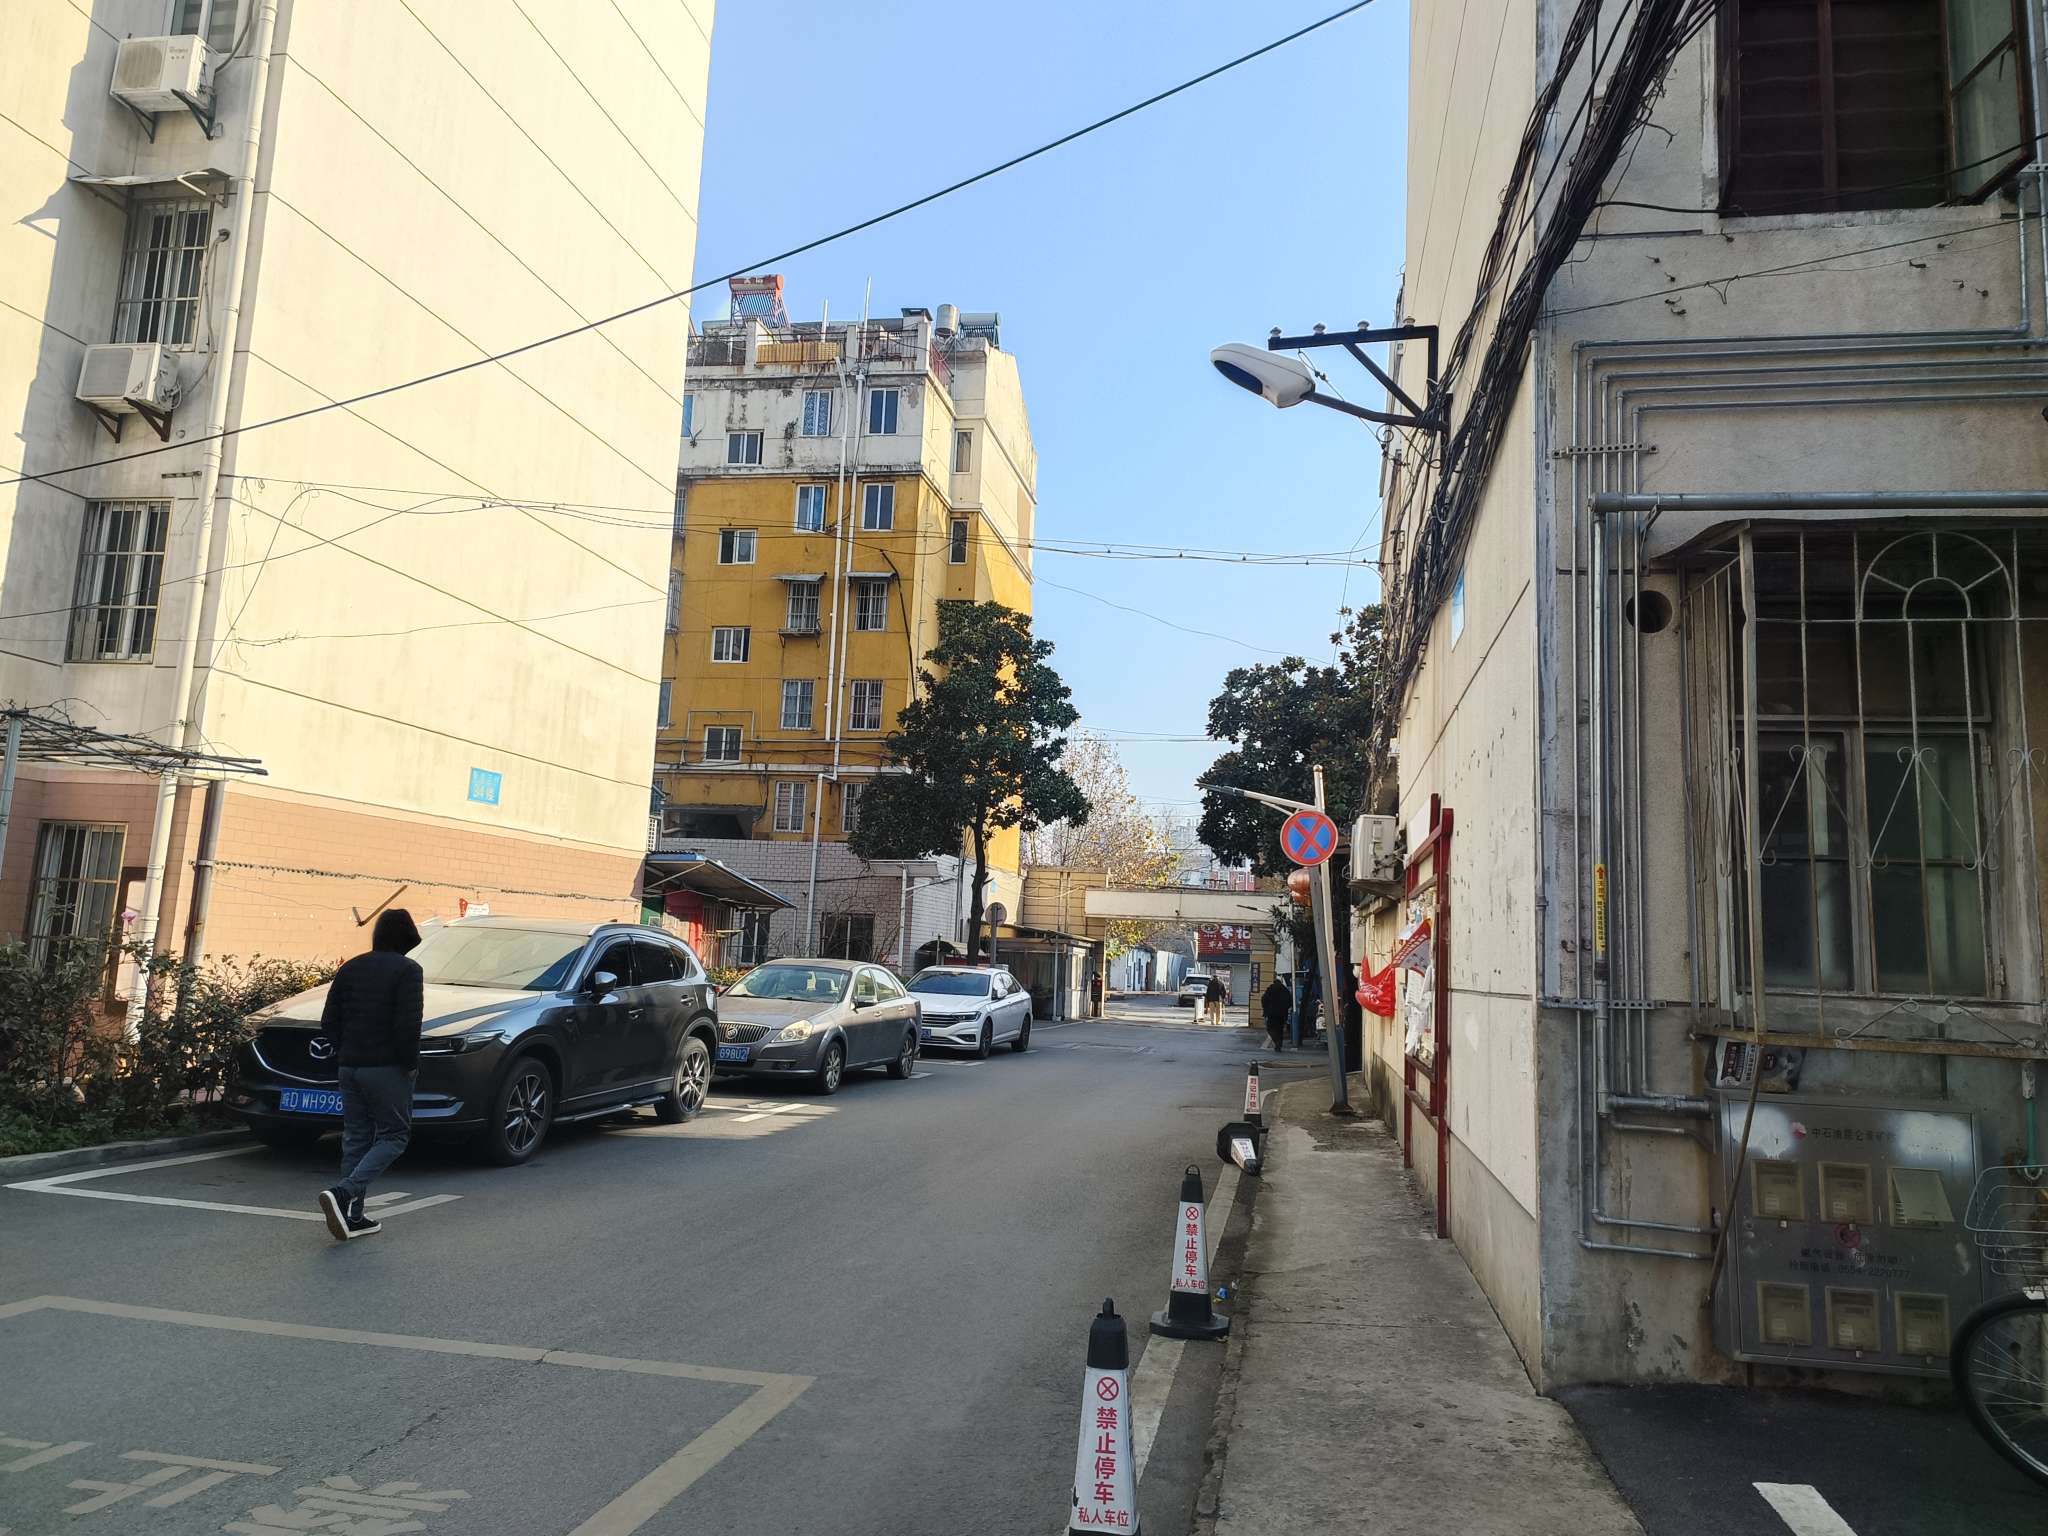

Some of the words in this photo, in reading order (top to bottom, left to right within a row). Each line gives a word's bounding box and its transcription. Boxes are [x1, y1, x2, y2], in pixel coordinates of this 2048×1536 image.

[1185, 1223, 1199, 1278] 禁止停车
[1176, 1278, 1207, 1290] 私人车位
[1093, 1406, 1118, 1506] 禁止停车
[1078, 1507, 1129, 1528] 私人车位
